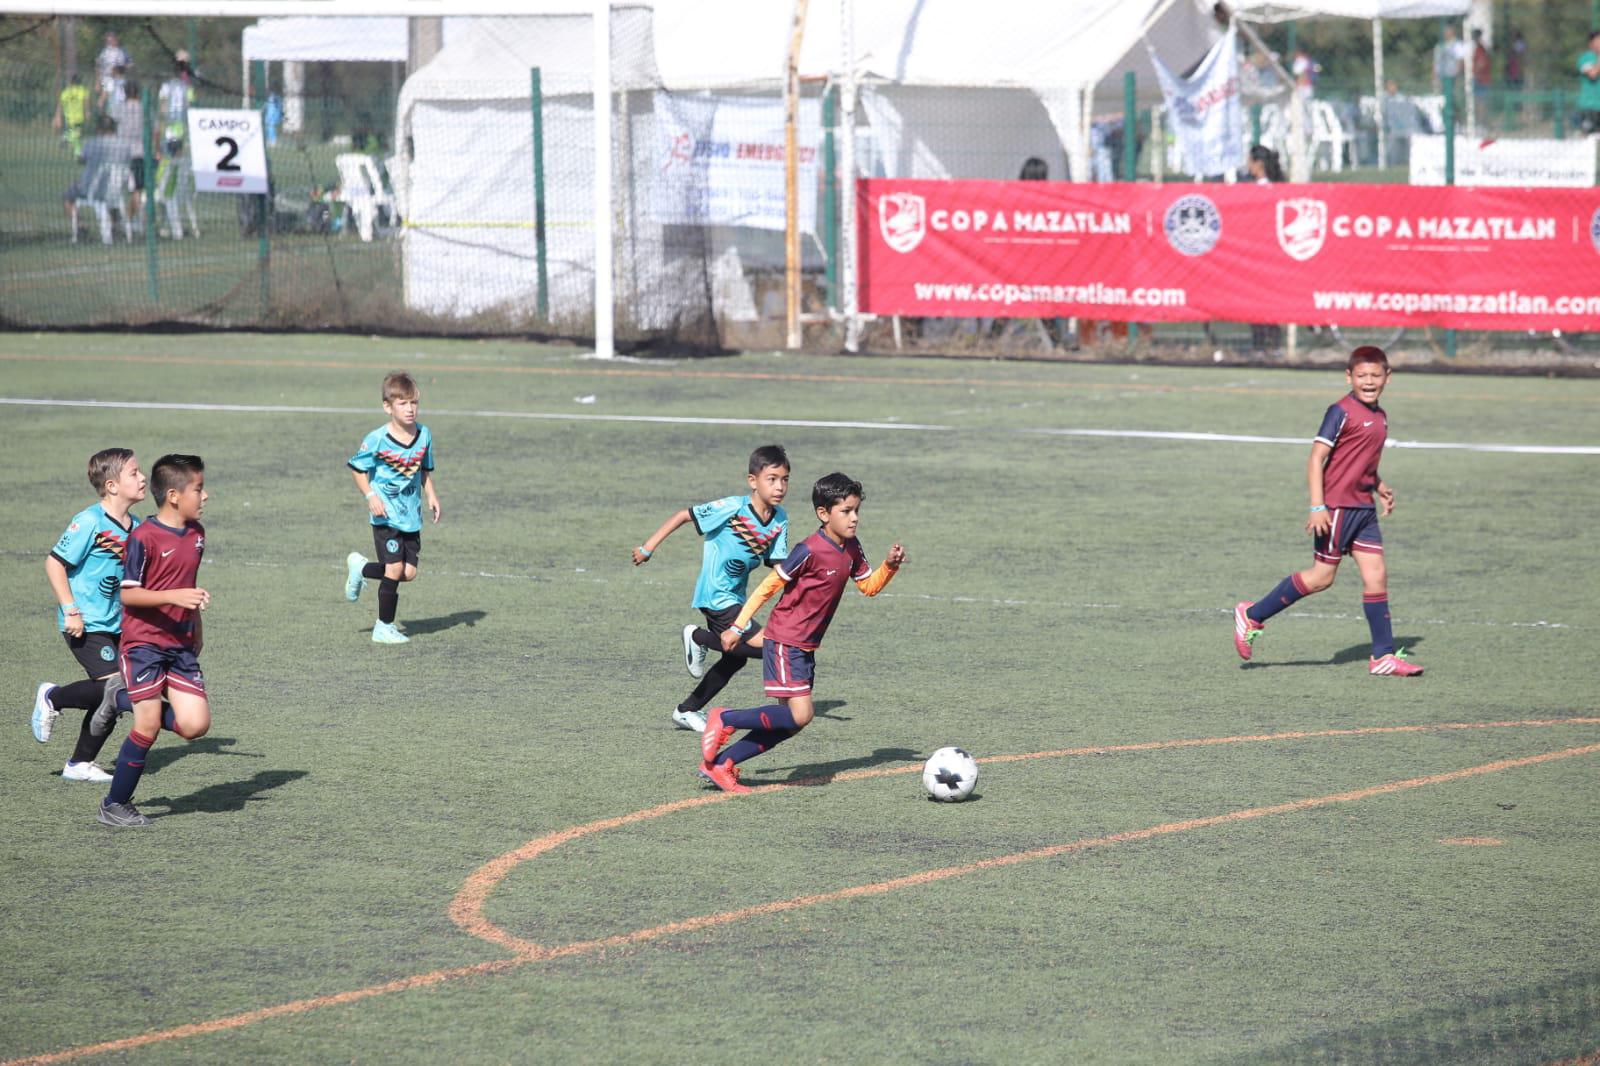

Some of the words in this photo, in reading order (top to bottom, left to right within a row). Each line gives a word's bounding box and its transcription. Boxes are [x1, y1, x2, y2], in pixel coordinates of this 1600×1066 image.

[198, 118, 250, 132] CAMPO
[215, 136, 241, 172] 2
[1013, 211, 1131, 234] MAZATLAN
[1418, 217, 1556, 240] MAZATLAN
[914, 282, 1186, 306] www.copamazatlan.com
